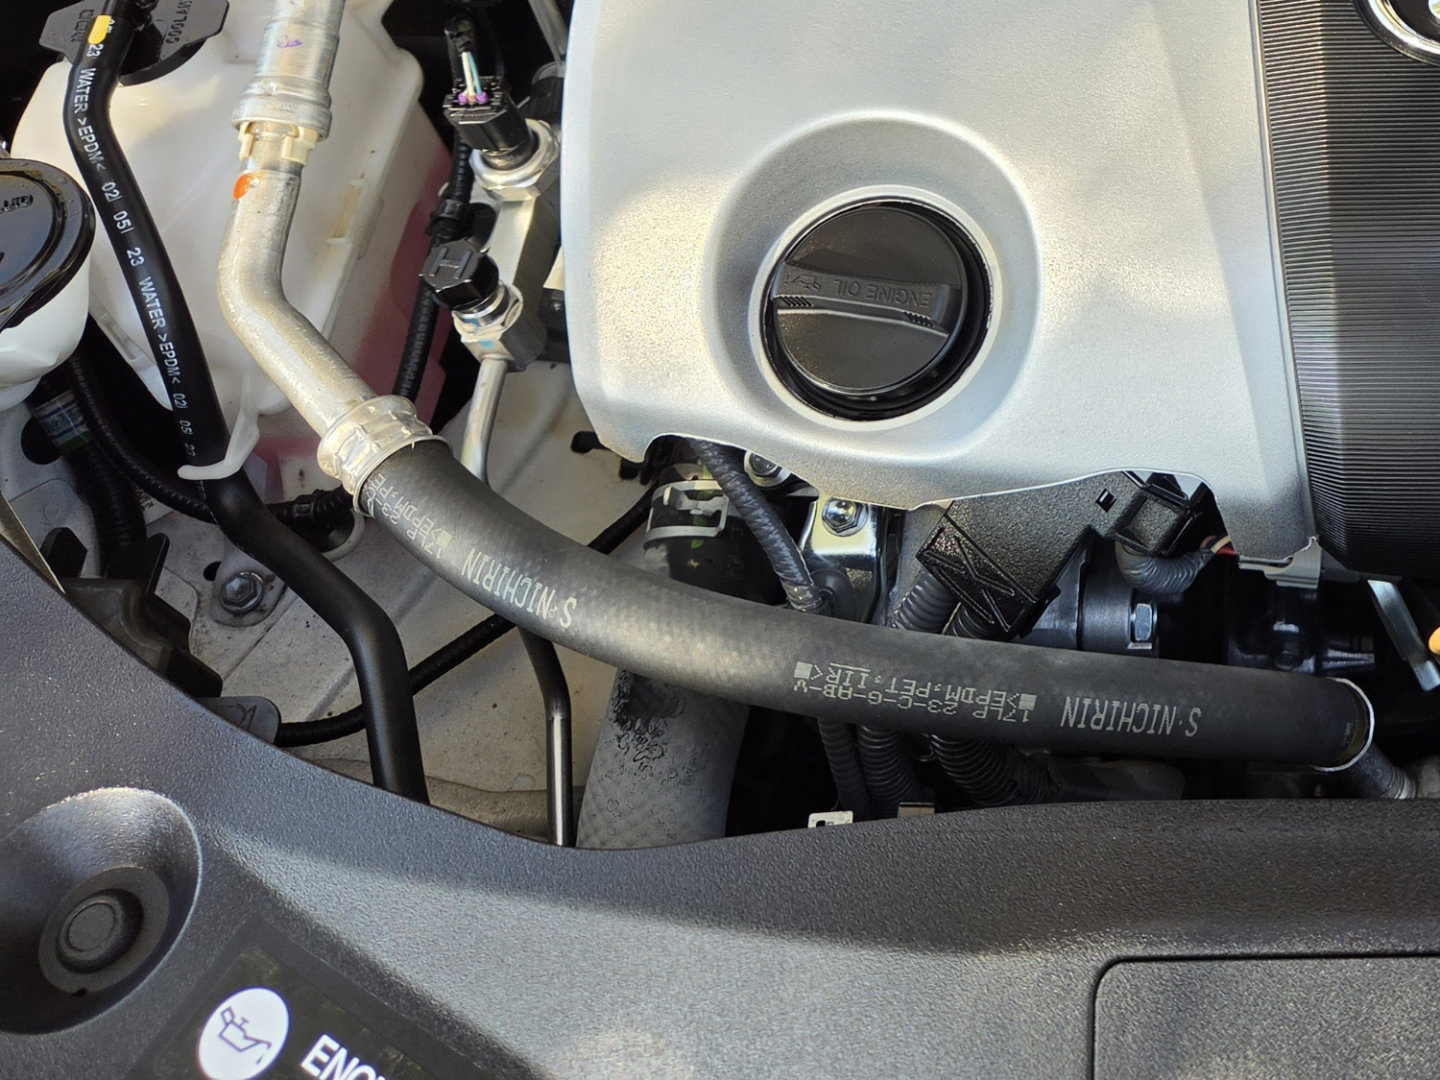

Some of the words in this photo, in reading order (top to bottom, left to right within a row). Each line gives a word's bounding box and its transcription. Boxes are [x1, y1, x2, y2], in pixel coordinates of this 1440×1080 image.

[87, 43, 104, 58] 23
[74, 67, 97, 114] WATER
[126, 247, 145, 267] 23
[833, 279, 861, 297] OIL
[865, 283, 933, 309] ENGINE
[138, 276, 167, 330] WATER
[973, 704, 1030, 724] 17LP
